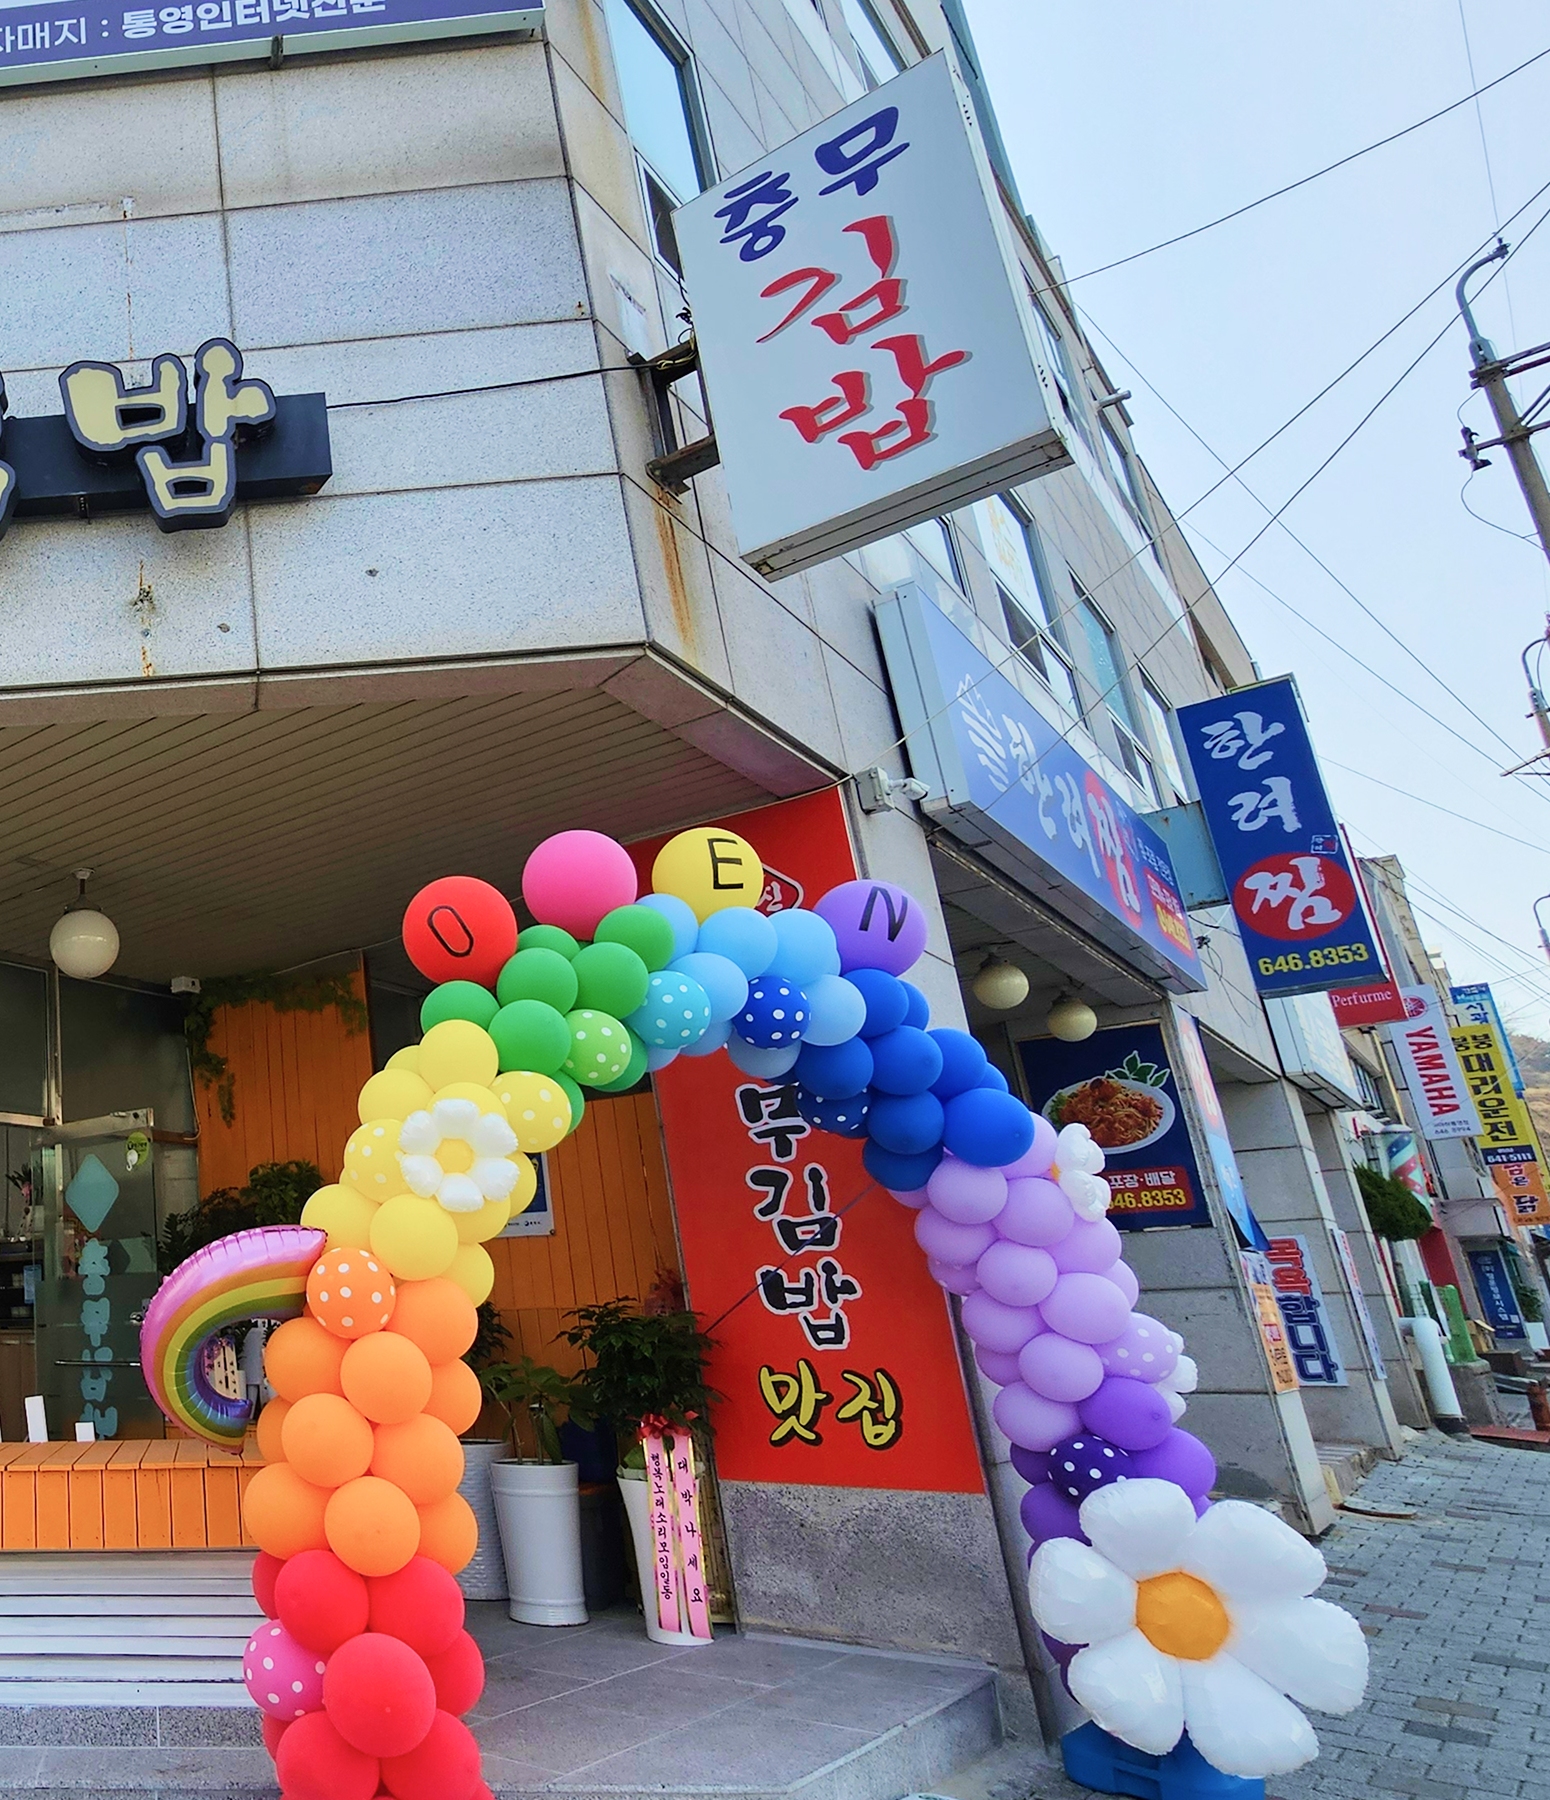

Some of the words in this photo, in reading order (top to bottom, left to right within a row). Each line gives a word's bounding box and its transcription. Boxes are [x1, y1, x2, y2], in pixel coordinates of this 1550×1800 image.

[715, 106, 910, 262] 충무
[756, 215, 970, 470] 김밥
[1002, 713, 1141, 914] 한려찜
[1201, 711, 1342, 930] 한려찜
[706, 837, 744, 890] E
[858, 886, 909, 943] N
[1258, 942, 1369, 976] 646.8353
[1331, 989, 1392, 1008] Perfurme
[1405, 1025, 1461, 1117] YAMAHA
[1462, 1052, 1519, 1143] 대리운전
[1109, 1188, 1187, 1210] 46.8353
[758, 1359, 903, 1450] 맛집
[677, 1457, 704, 1603] 대박나세요
